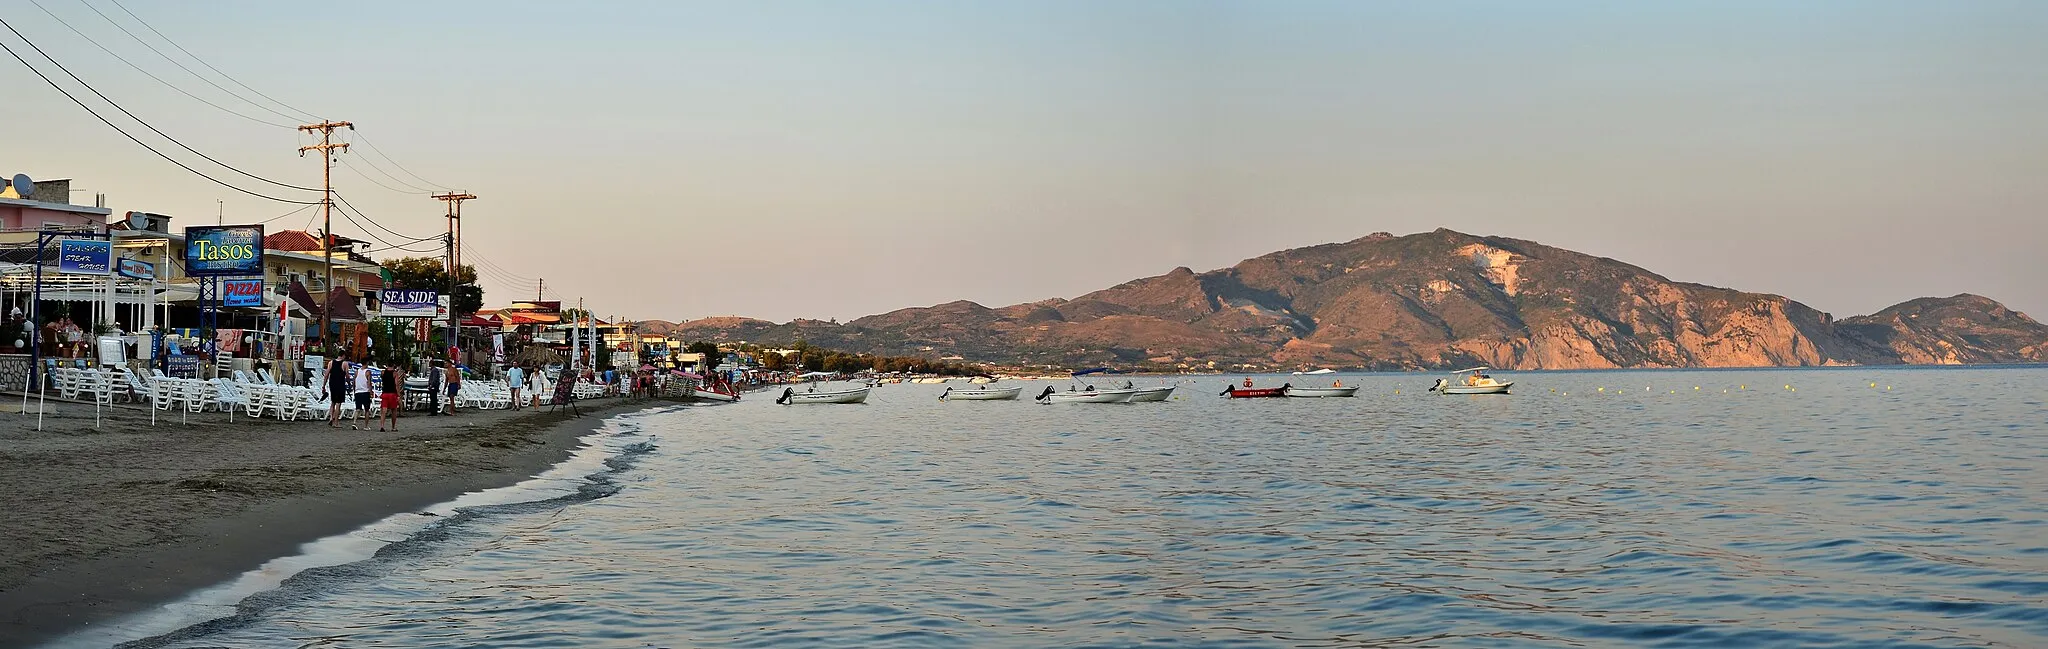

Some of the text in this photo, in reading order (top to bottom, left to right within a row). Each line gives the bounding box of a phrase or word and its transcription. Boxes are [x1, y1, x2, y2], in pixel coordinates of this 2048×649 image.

[194, 240, 254, 261] Tasos
[64, 254, 92, 262] STEAK
[78, 263, 105, 271] HOUSE
[225, 282, 261, 297] PIZZA
[225, 295, 259, 305] Home made
[383, 290, 405, 303] SEA
[407, 291, 436, 304] SIDE
